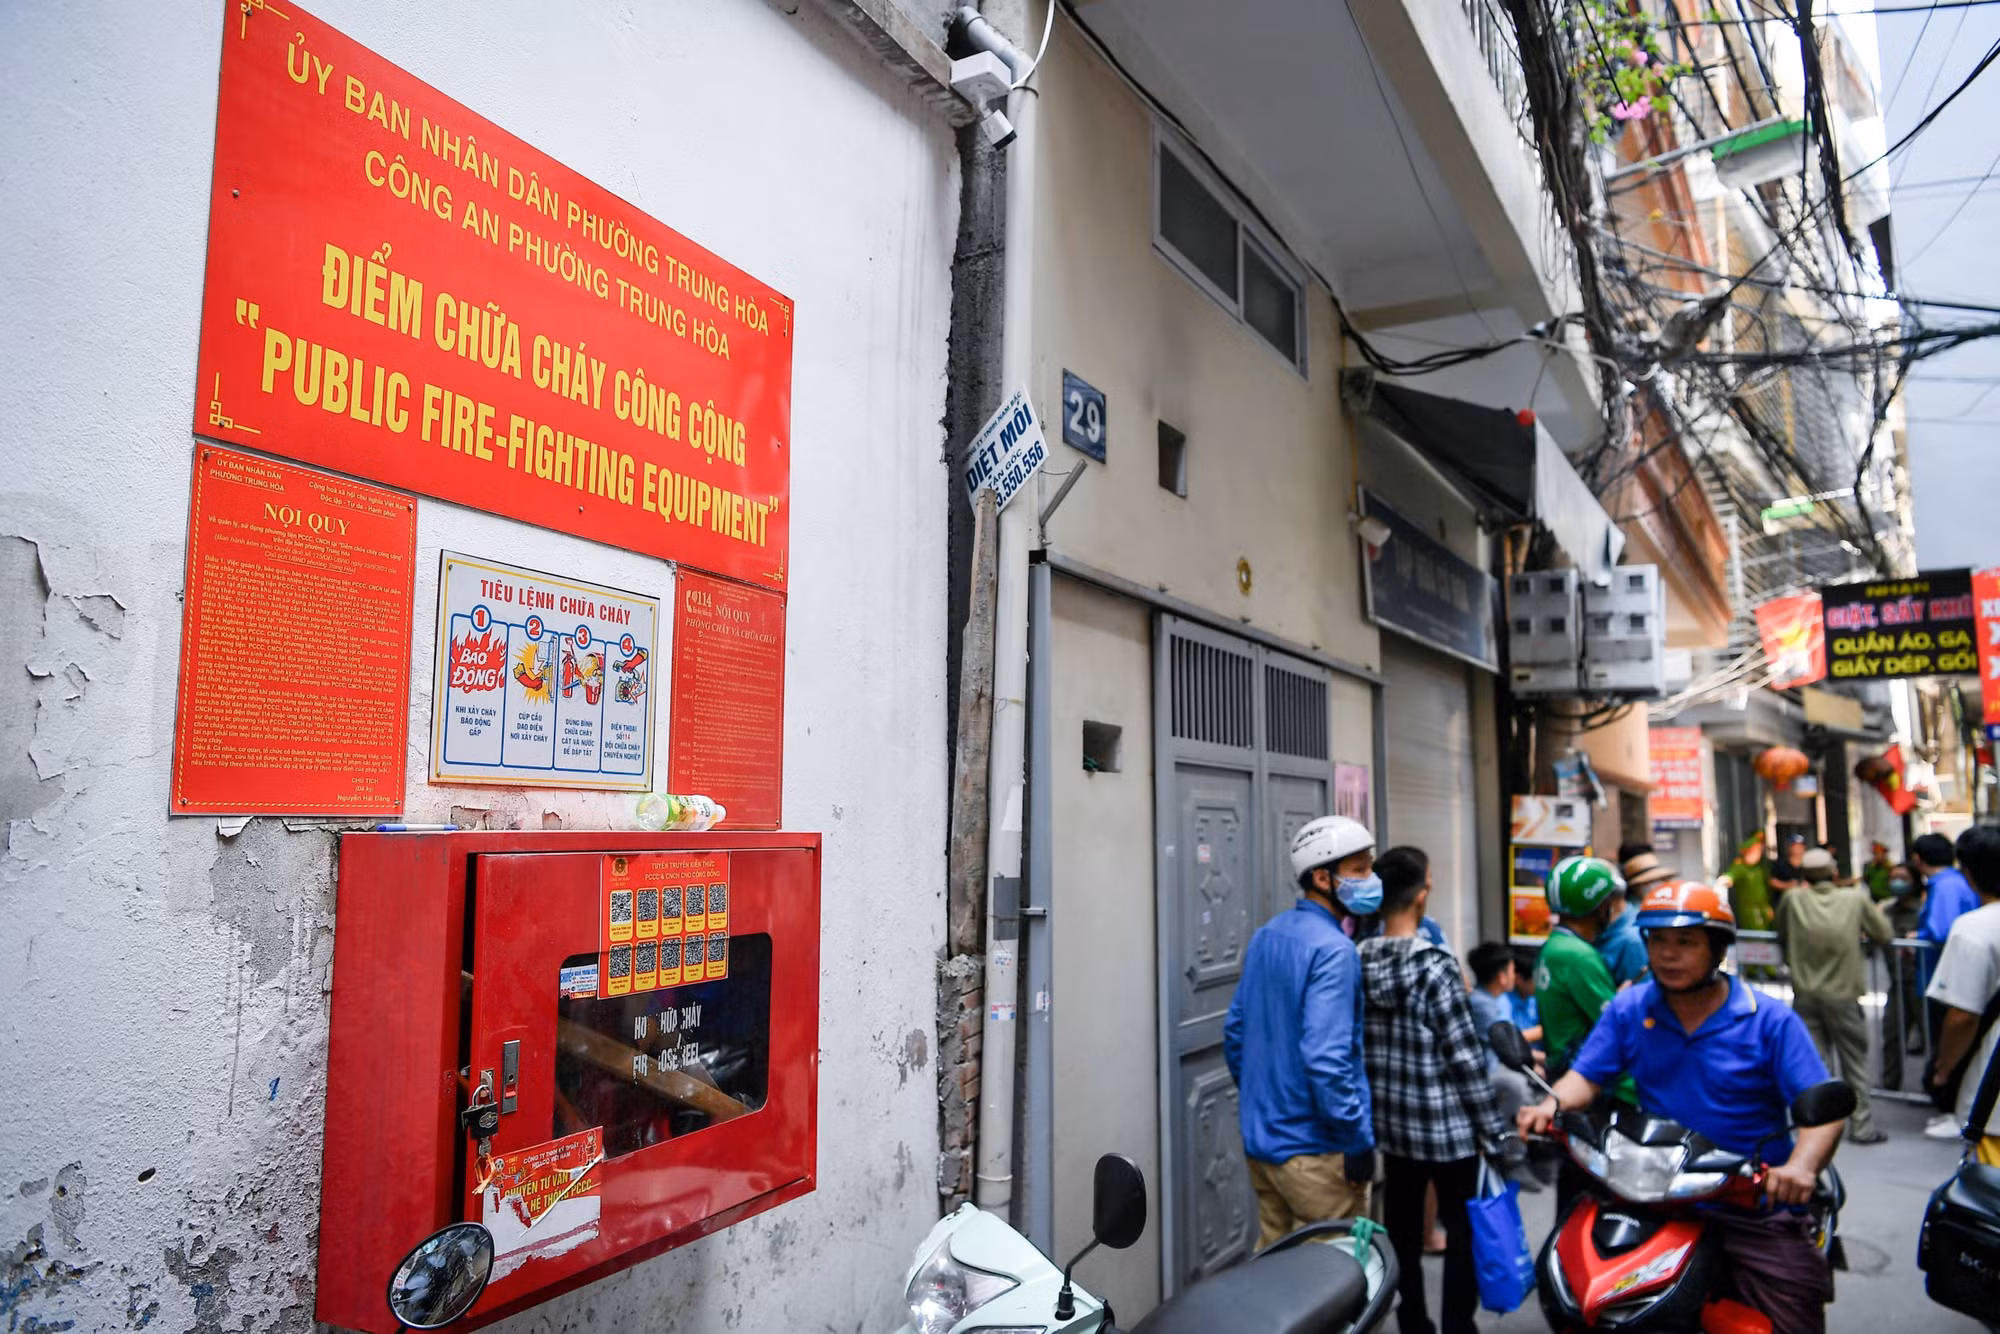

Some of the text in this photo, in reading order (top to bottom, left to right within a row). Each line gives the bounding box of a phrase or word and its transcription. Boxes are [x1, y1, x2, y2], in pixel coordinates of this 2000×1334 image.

[287, 32, 768, 336] ỦY BAN NHÂN DÂN PHƯỜNG TRUNG HÒA
[365, 150, 729, 360] CÔNG AN PHƯỜNG TRUNG HÒA
[322, 242, 745, 467] ĐIỂM CHỮA CHÁY CÔNG CỘNG
[1070, 390, 1101, 444] 29
[421, 383, 634, 505] FIRE-FIGHTING
[966, 400, 1032, 494] DIỆT MỐI
[209, 468, 284, 491] PHƯỜNG TRUNG HÒA
[228, 461, 244, 471] BAN
[245, 465, 265, 475] NHÂN
[266, 470, 281, 479] DÂN
[263, 502, 350, 536] NỘI QUY
[481, 578, 631, 625] TIÊU LỆNH CHỮA CHÁY
[697, 591, 712, 608] 114
[474, 608, 485, 627] 1
[716, 604, 731, 620] NỘI
[733, 610, 751, 623] QUY
[528, 618, 540, 636] 2
[577, 627, 588, 645] 3
[712, 622, 730, 634] CHÁY
[759, 632, 776, 644] CHÁY
[621, 636, 632, 652] 4
[460, 647, 488, 664] BÁO
[455, 705, 466, 713] KHI
[480, 705, 497, 717] CHÁY
[460, 714, 473, 725] BÁO
[516, 722, 528, 730] DAO
[533, 732, 548, 742] CHÁY
[656, 1006, 678, 1034] HỮA
